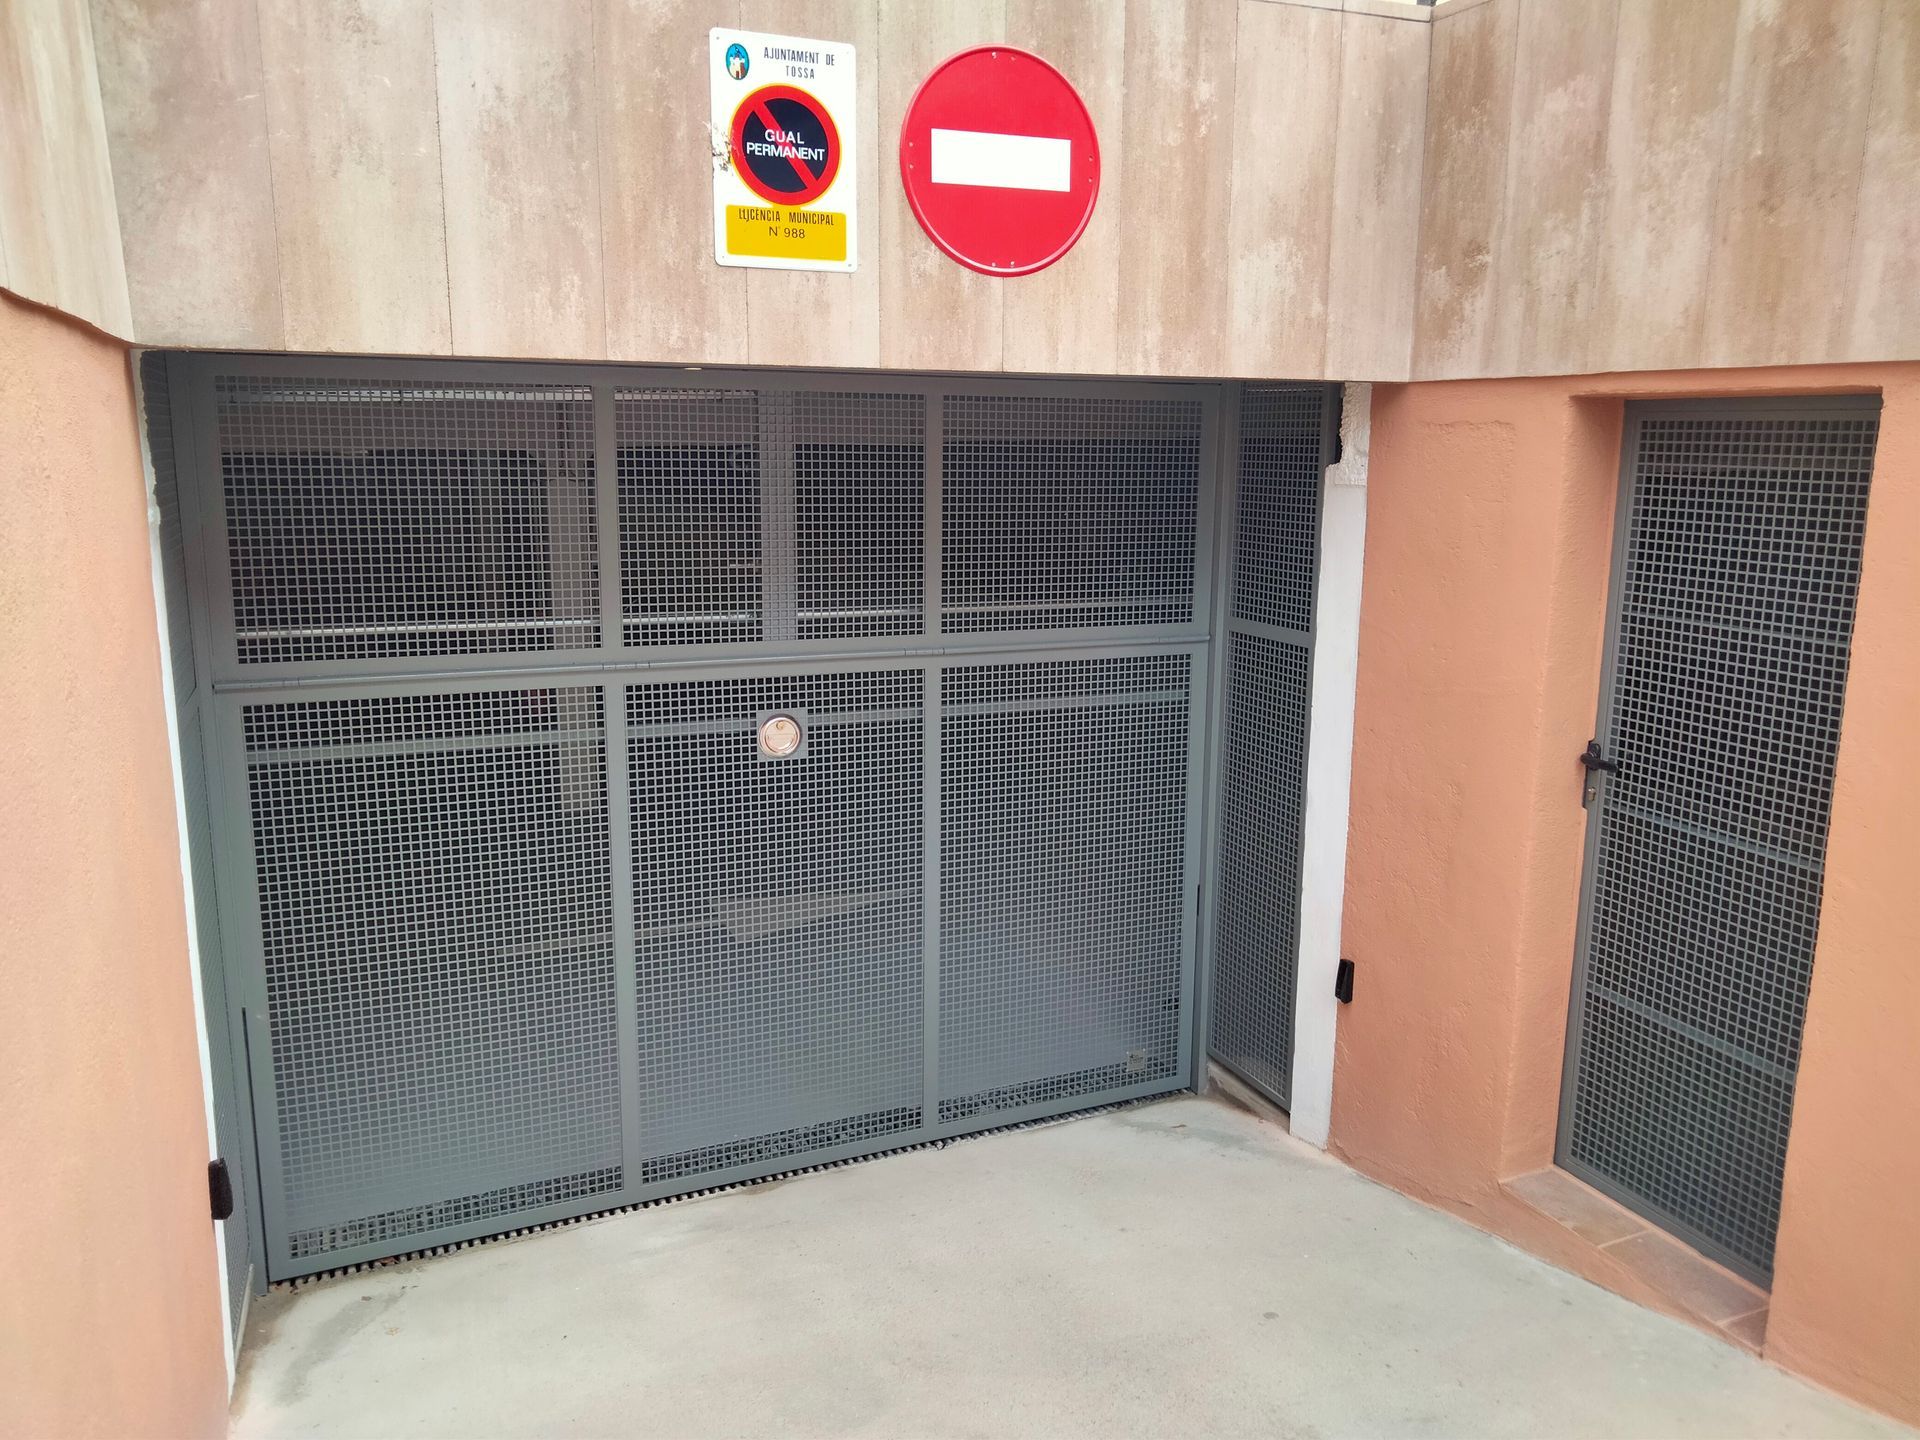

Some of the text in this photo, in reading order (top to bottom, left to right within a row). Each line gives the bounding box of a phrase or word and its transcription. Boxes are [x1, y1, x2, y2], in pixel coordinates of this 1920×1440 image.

[763, 47, 835, 66] AJUNTAMENT DE
[785, 65, 815, 79] TOSSA
[765, 129, 804, 145] GUAL
[747, 143, 825, 161] PERMANENT
[789, 212, 834, 226] MUNICIPAL
[784, 227, 805, 239] 988
